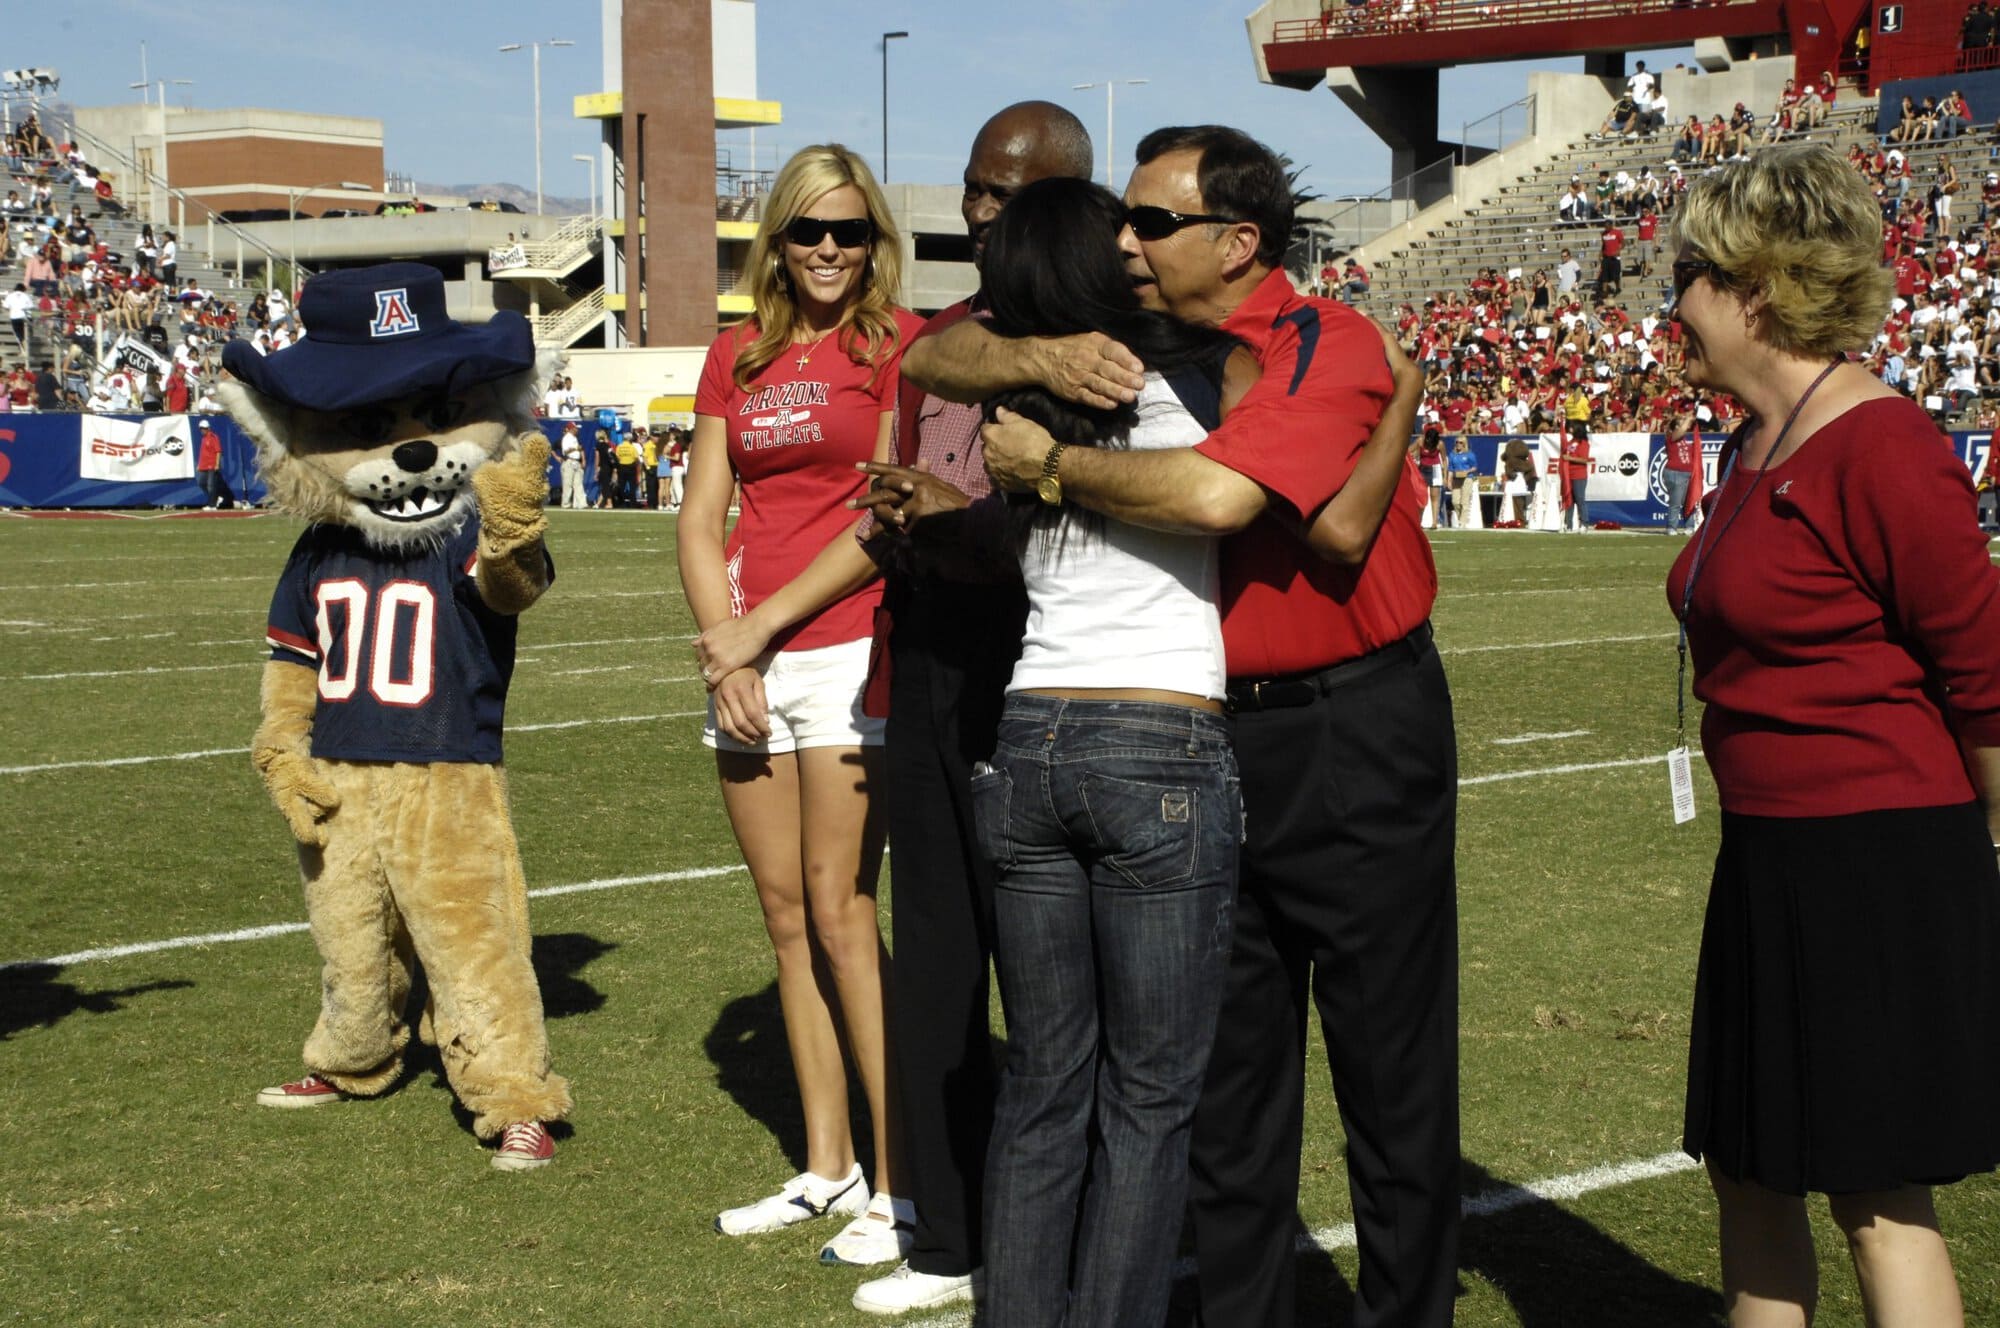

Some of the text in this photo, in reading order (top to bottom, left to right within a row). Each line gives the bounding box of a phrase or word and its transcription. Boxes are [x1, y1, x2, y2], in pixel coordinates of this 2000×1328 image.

[1884, 6, 1896, 26] 1
[370, 288, 420, 337] A
[75, 325, 94, 337] 30
[740, 381, 830, 415] ARIZONA
[741, 422, 822, 451] WILDCATS
[1598, 464, 1617, 473] ON
[1618, 456, 1640, 472] abc
[314, 576, 437, 708] 00
